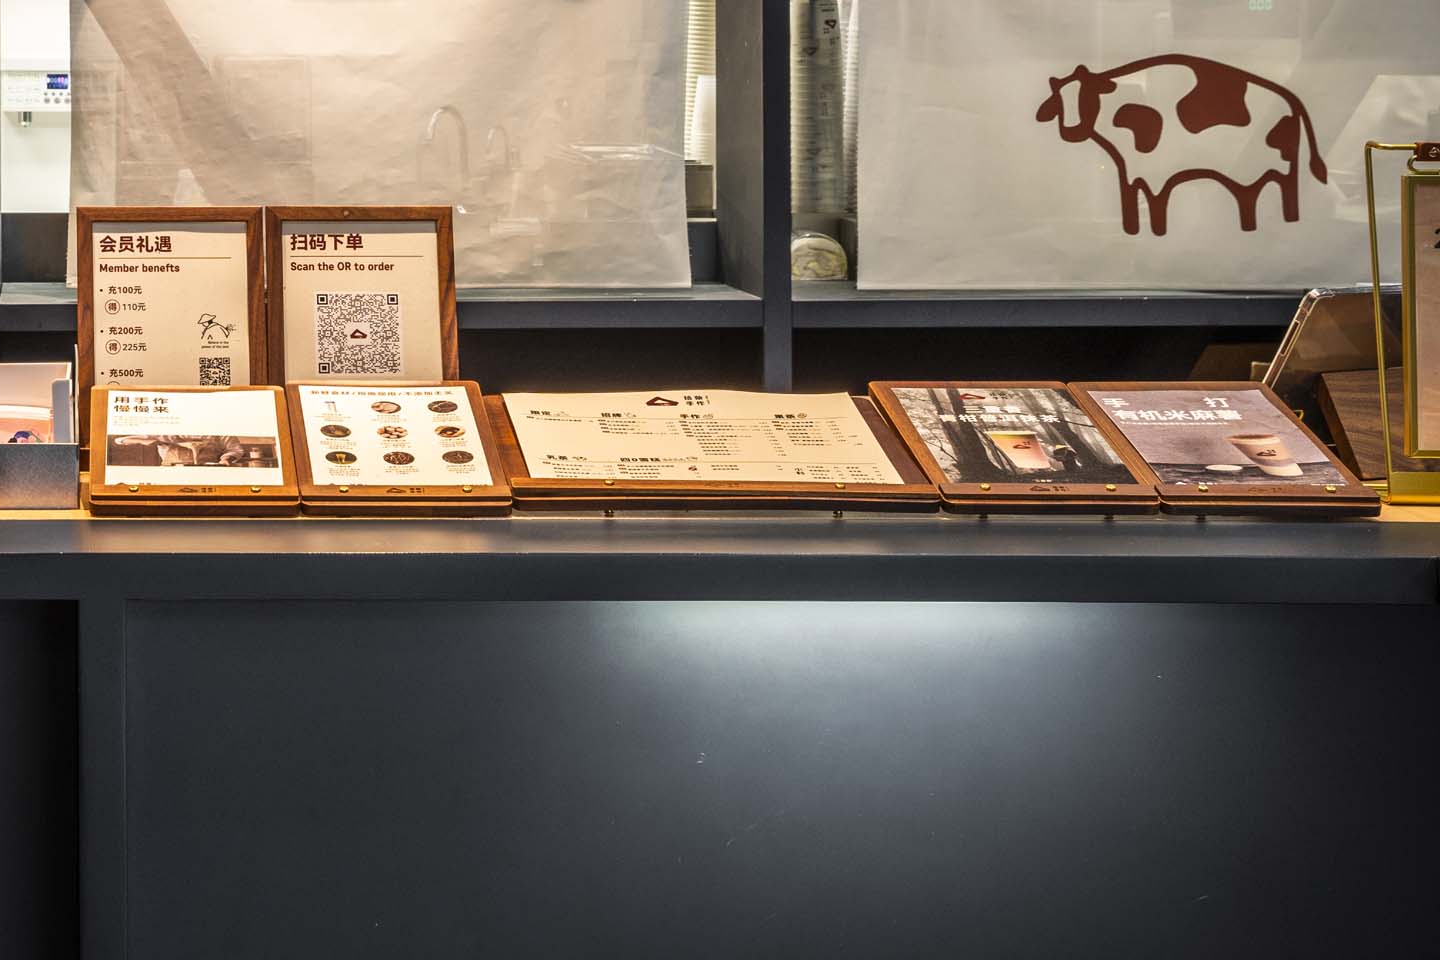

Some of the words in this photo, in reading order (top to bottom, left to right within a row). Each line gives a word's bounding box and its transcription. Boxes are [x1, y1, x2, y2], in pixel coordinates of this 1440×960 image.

[99, 235, 173, 253] 会员礼遇
[290, 233, 364, 251] 扫码下单
[99, 263, 139, 273] Member
[290, 262, 315, 271] Scan
[317, 262, 335, 271] the
[354, 262, 365, 271] to
[367, 262, 395, 271] order
[108, 285, 143, 295] 充100元
[122, 302, 147, 311] 110元
[108, 326, 144, 335] 充200元
[122, 342, 147, 351] 225元
[109, 368, 144, 378] 充500元
